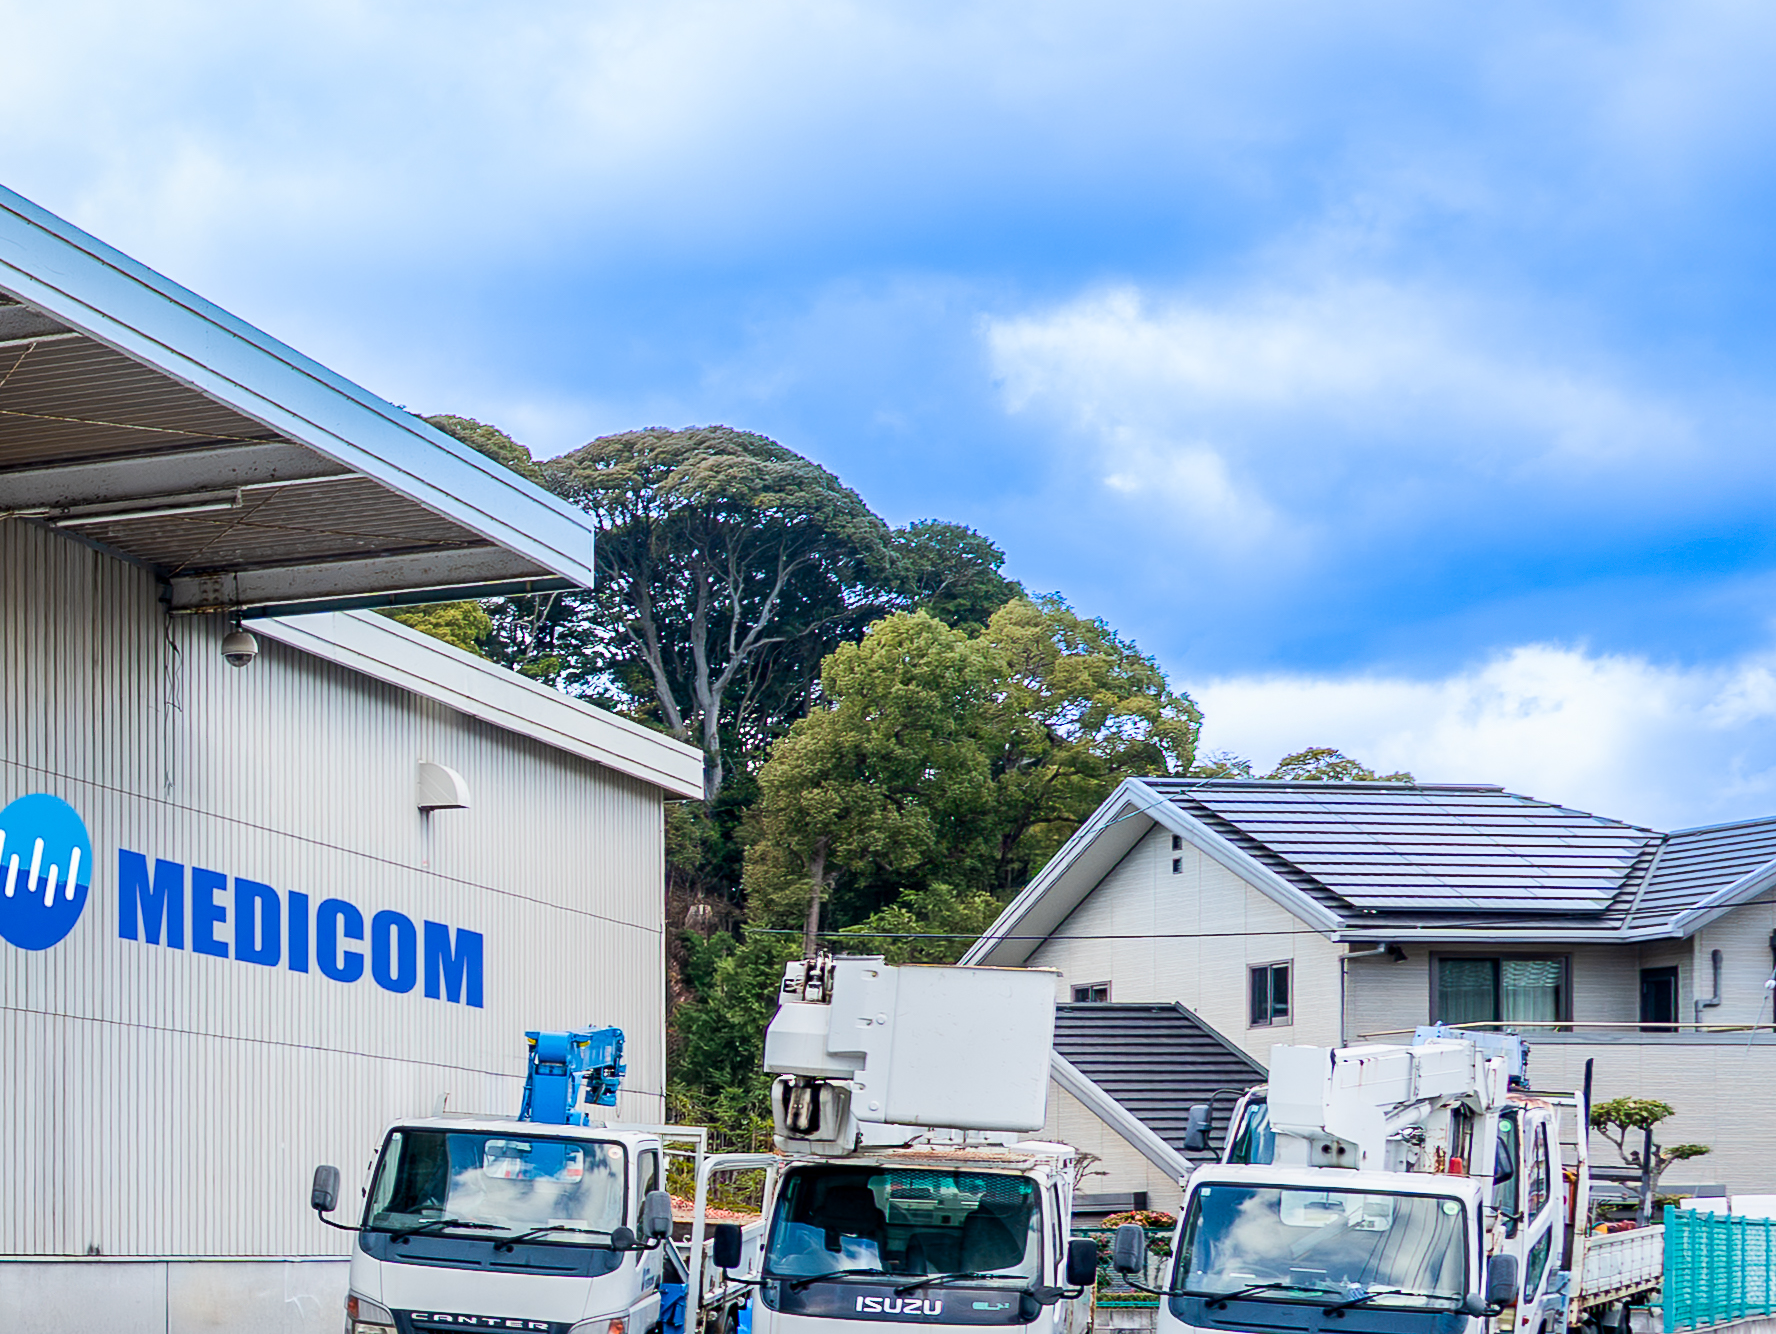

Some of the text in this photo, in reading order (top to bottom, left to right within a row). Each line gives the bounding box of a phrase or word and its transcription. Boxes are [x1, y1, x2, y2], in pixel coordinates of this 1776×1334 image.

[118, 848, 484, 1009] MEDICOM
[855, 1295, 942, 1316] ISUZU
[411, 1312, 549, 1330] CANTER
